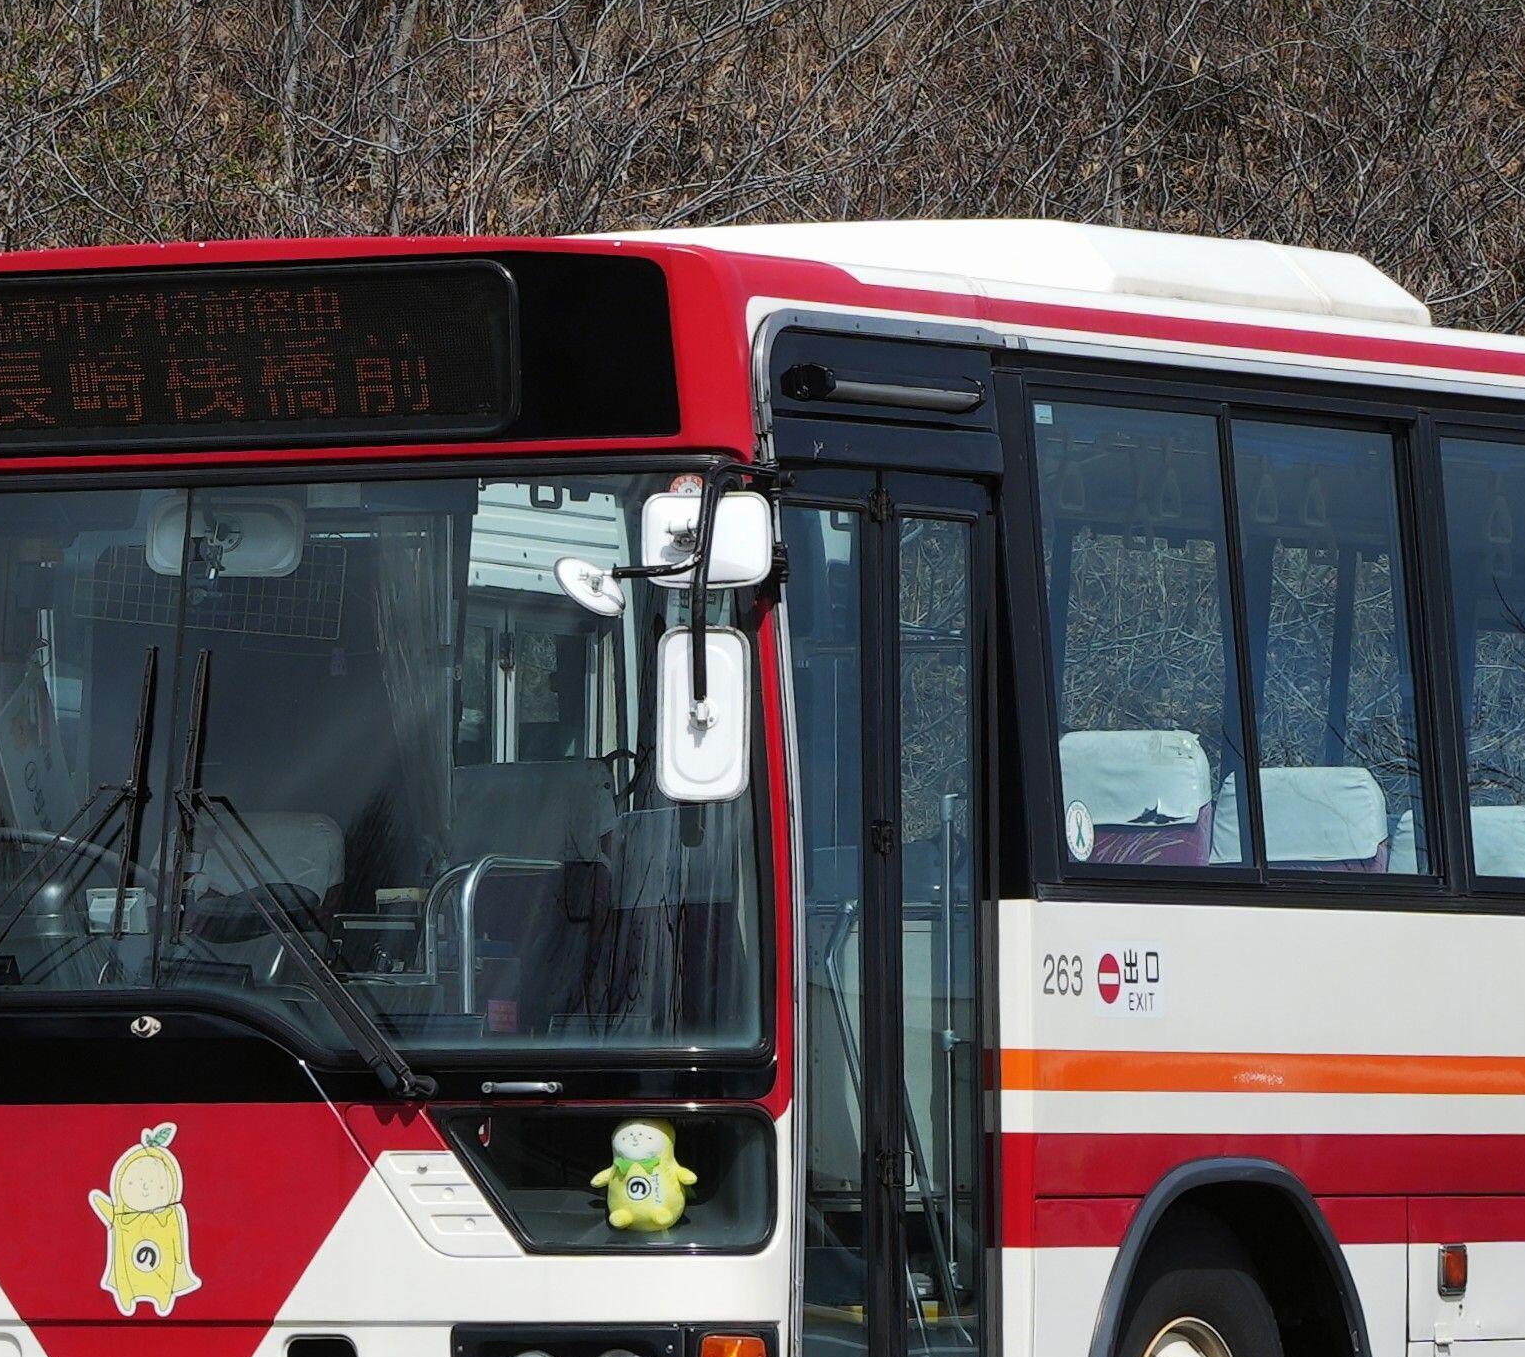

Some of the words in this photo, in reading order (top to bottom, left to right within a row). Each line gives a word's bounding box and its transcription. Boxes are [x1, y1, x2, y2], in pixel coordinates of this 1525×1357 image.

[1043, 953, 1084, 996] 263
[1123, 948, 1159, 984] 出口
[1128, 991, 1155, 1012] EXIT
[136, 1246, 157, 1268] の
